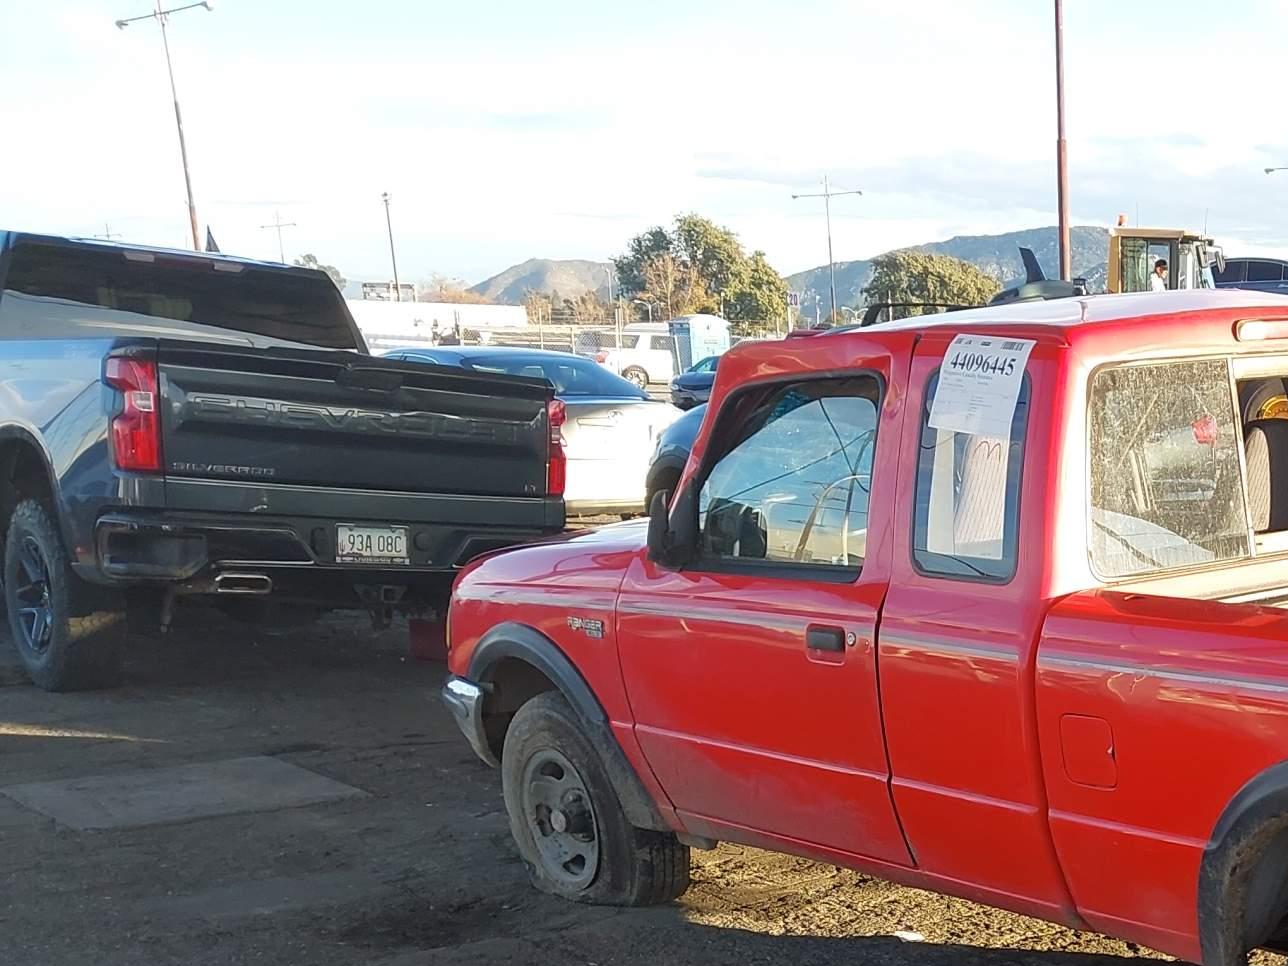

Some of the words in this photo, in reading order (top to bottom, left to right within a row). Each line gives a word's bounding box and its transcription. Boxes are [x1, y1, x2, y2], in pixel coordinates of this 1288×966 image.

[950, 351, 1017, 376] 44096445
[172, 462, 275, 476] SILVERADO
[348, 534, 372, 553] 93A
[378, 535, 402, 553] 08C
